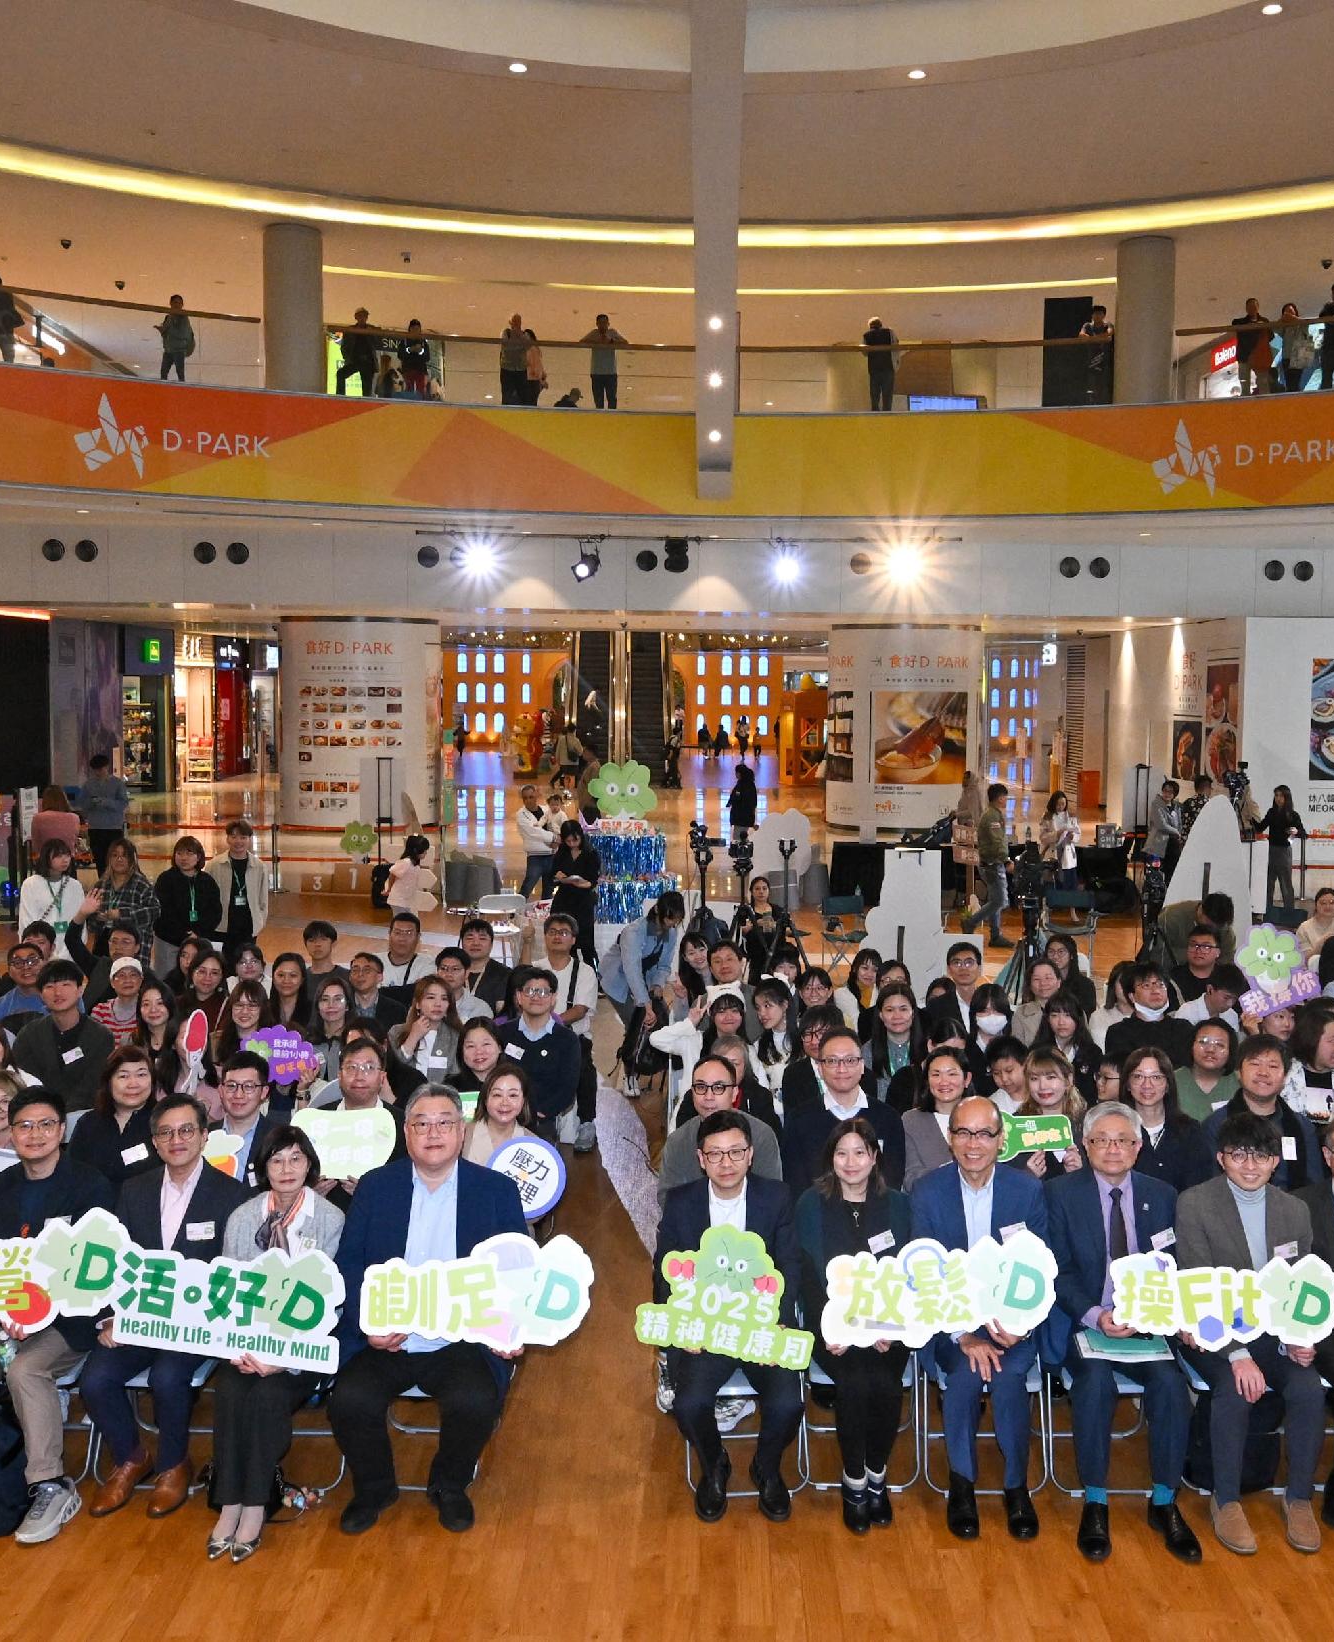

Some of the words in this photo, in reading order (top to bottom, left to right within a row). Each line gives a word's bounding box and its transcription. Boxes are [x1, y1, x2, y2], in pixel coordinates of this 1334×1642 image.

[313, 876, 322, 891] 3
[349, 868, 357, 890] 1
[509, 1147, 551, 1181] 壓力
[673, 1283, 776, 1324] 2025
[120, 1317, 180, 1342] Healthy
[183, 1325, 211, 1345] Life
[227, 1332, 286, 1357] Healthy
[291, 1341, 330, 1361] Mind
[641, 1309, 809, 1367] 精神健康月
